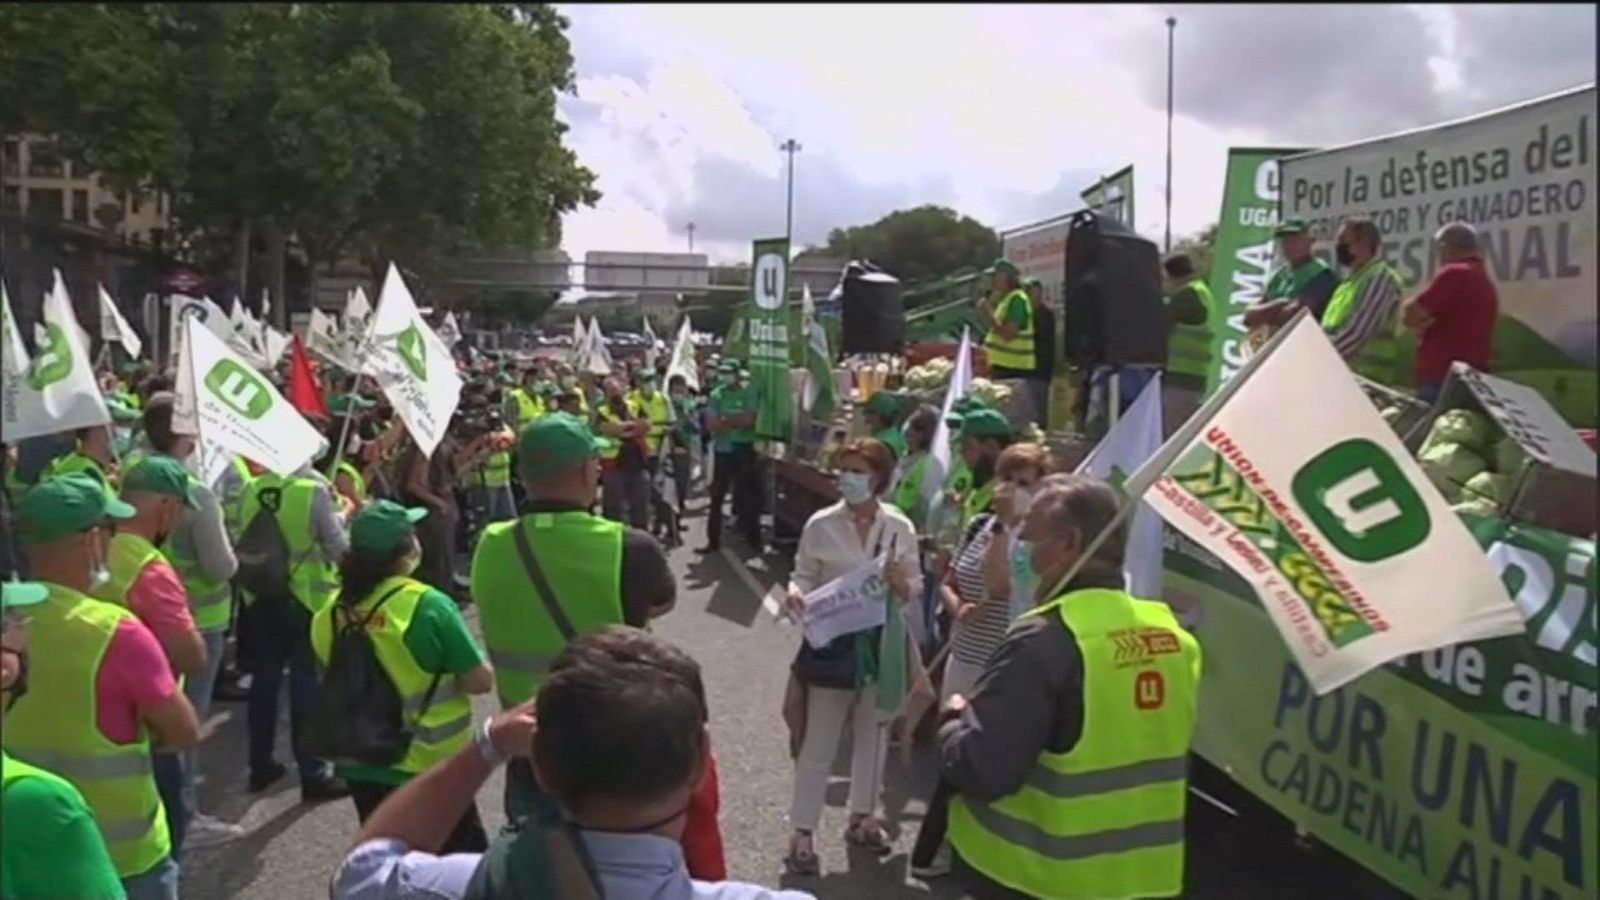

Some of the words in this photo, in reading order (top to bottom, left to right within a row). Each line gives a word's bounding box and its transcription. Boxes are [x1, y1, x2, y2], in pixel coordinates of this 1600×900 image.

[1293, 176, 1335, 212] Por
[1343, 166, 1368, 204] la
[1379, 145, 1509, 200] defensa
[1525, 114, 1589, 174] del
[1416, 202, 1432, 229] Y
[1437, 179, 1587, 226] GANADERO
[1261, 740, 1427, 876] CADENA
[1275, 660, 1388, 781] POR
[1411, 717, 1584, 889] UNA
